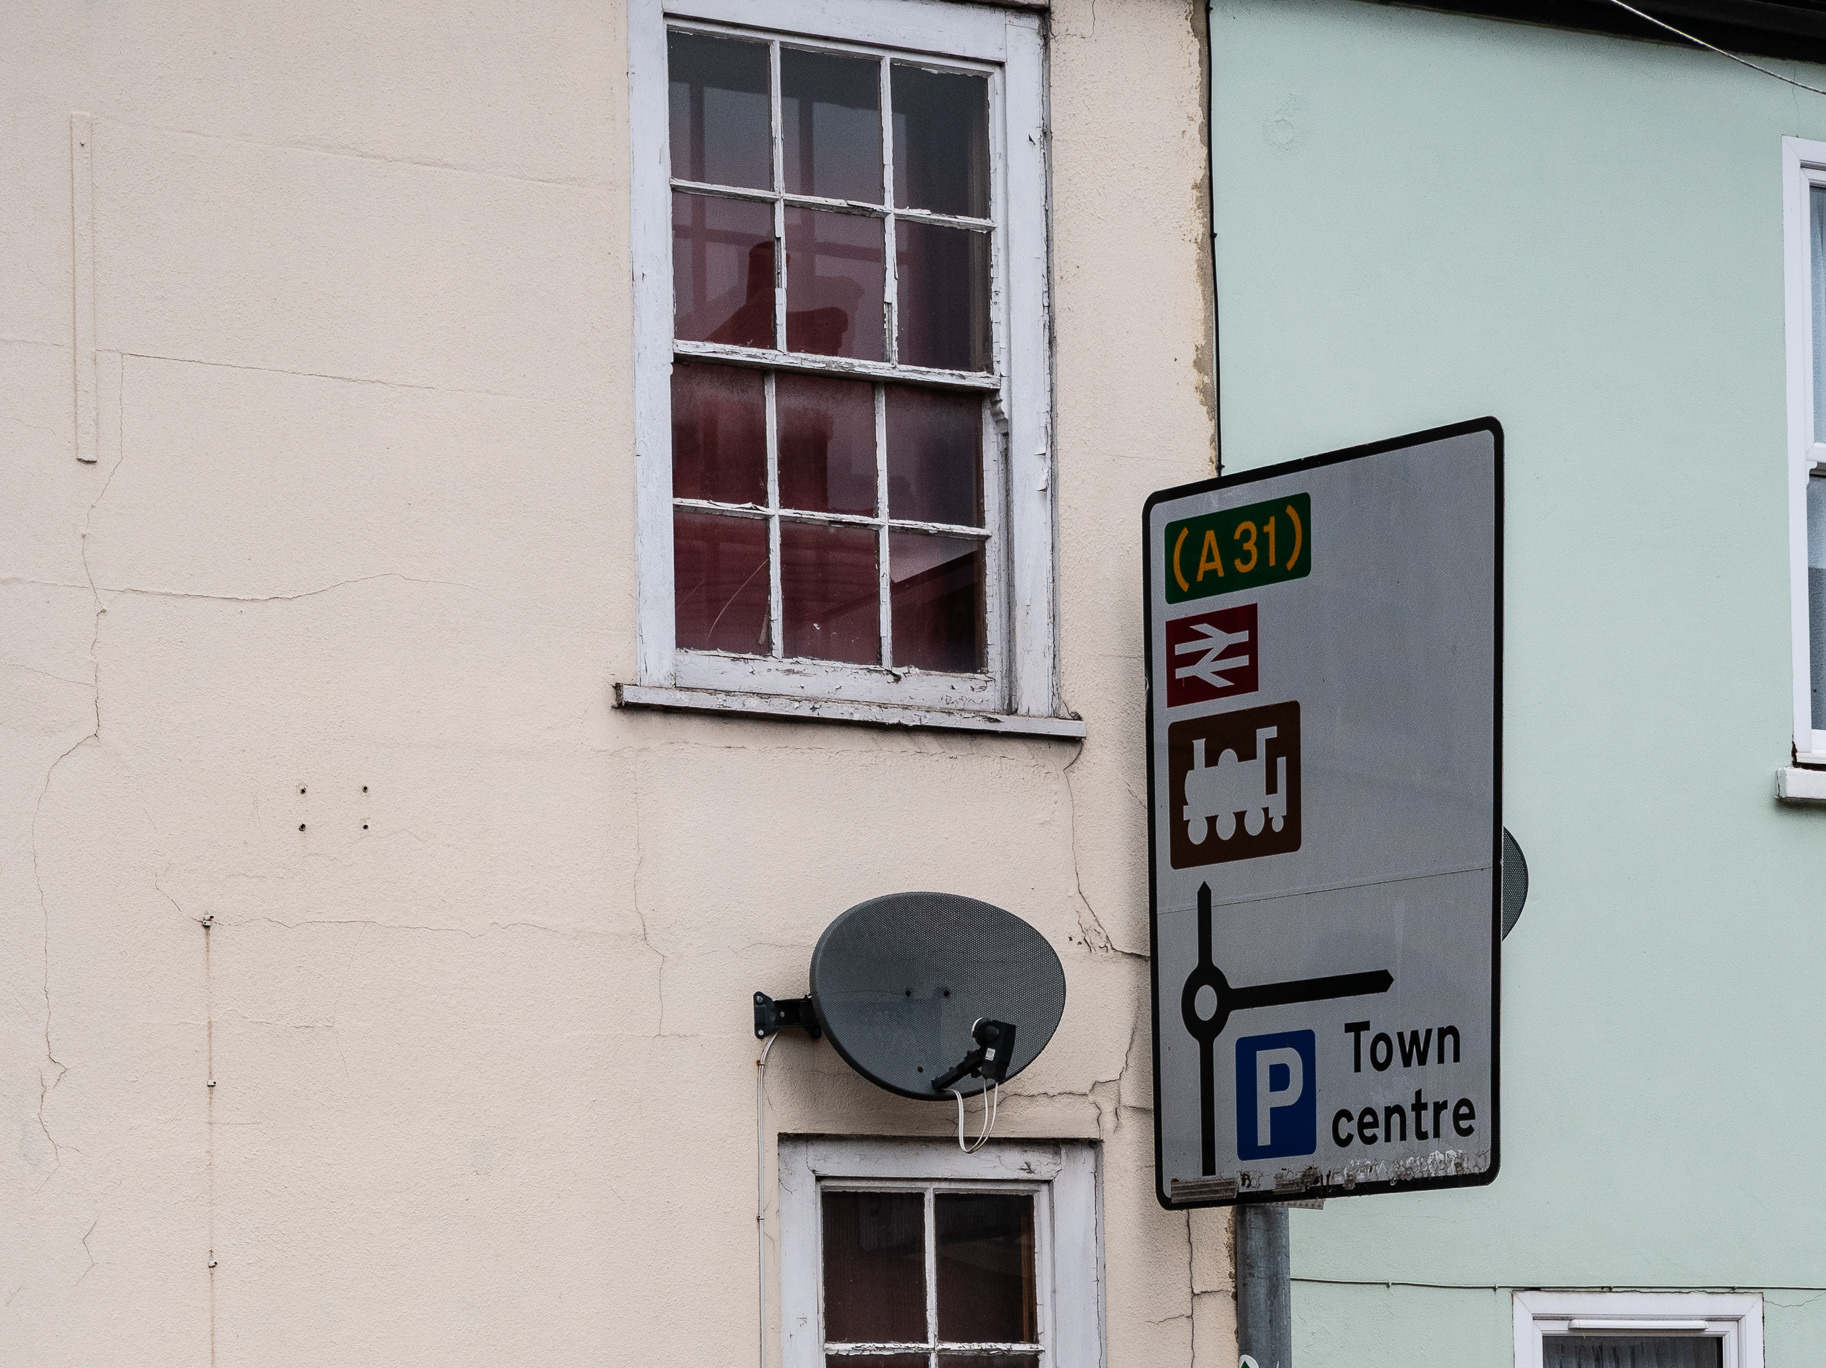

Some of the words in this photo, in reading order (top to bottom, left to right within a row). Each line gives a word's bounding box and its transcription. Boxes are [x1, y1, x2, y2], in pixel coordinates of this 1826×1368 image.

[1344, 1020, 1461, 1073] Town
[1256, 1046, 1304, 1147] P
[1331, 1087, 1476, 1149] centre
